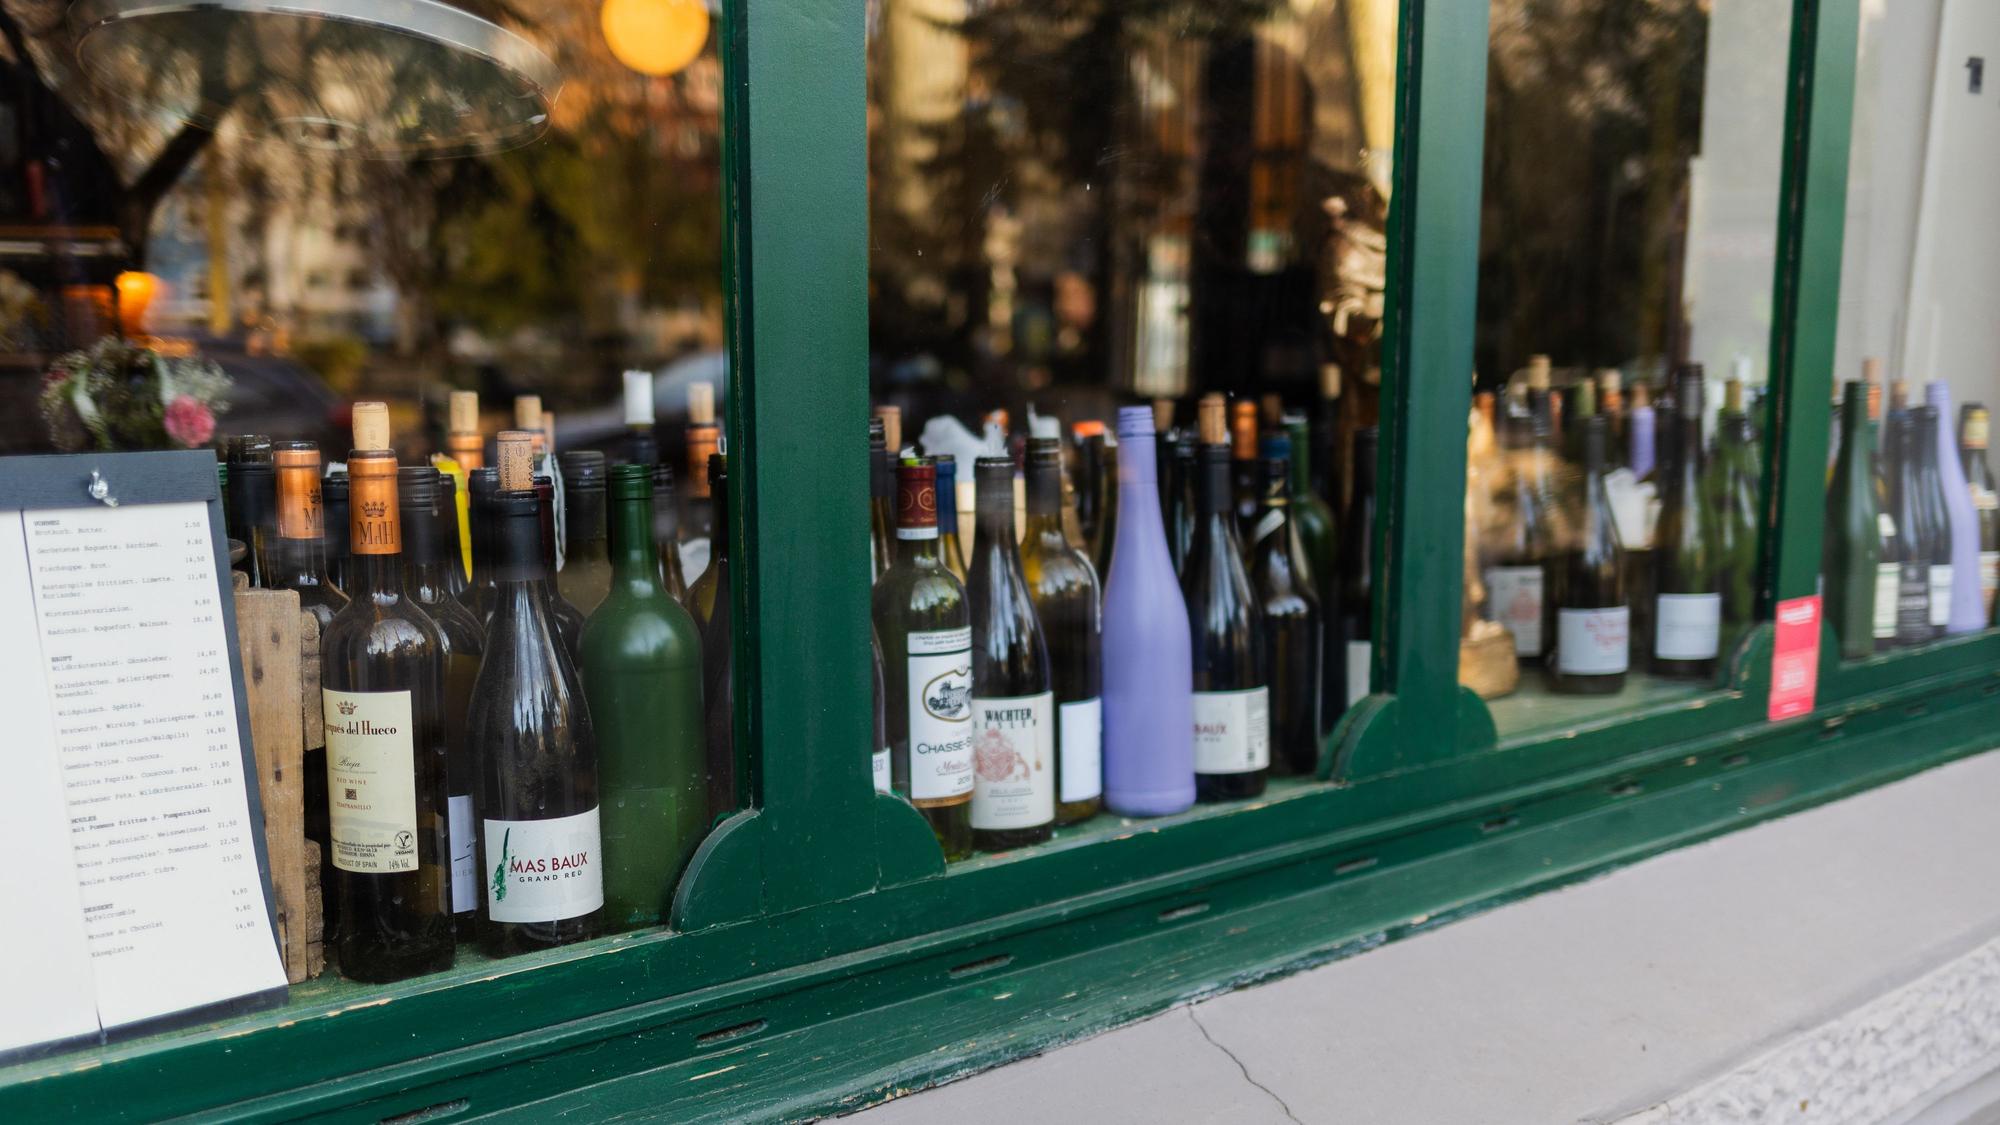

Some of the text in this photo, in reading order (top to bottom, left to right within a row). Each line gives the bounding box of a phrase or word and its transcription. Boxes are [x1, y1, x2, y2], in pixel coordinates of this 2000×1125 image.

[1965, 57, 1984, 94] 1
[94, 623, 135, 632] Roquefort.
[985, 708, 1032, 722] WACHTER
[346, 721, 359, 735] del
[361, 720, 397, 736] Hueco
[349, 778, 367, 786] WINE
[163, 807, 211, 820] Pumpernickel
[354, 860, 361, 868] OF
[362, 861, 378, 869] SPAIN
[510, 851, 588, 874] MAS BAUX
[519, 870, 582, 883] GRAND RED
[130, 921, 163, 932] Chocolat
